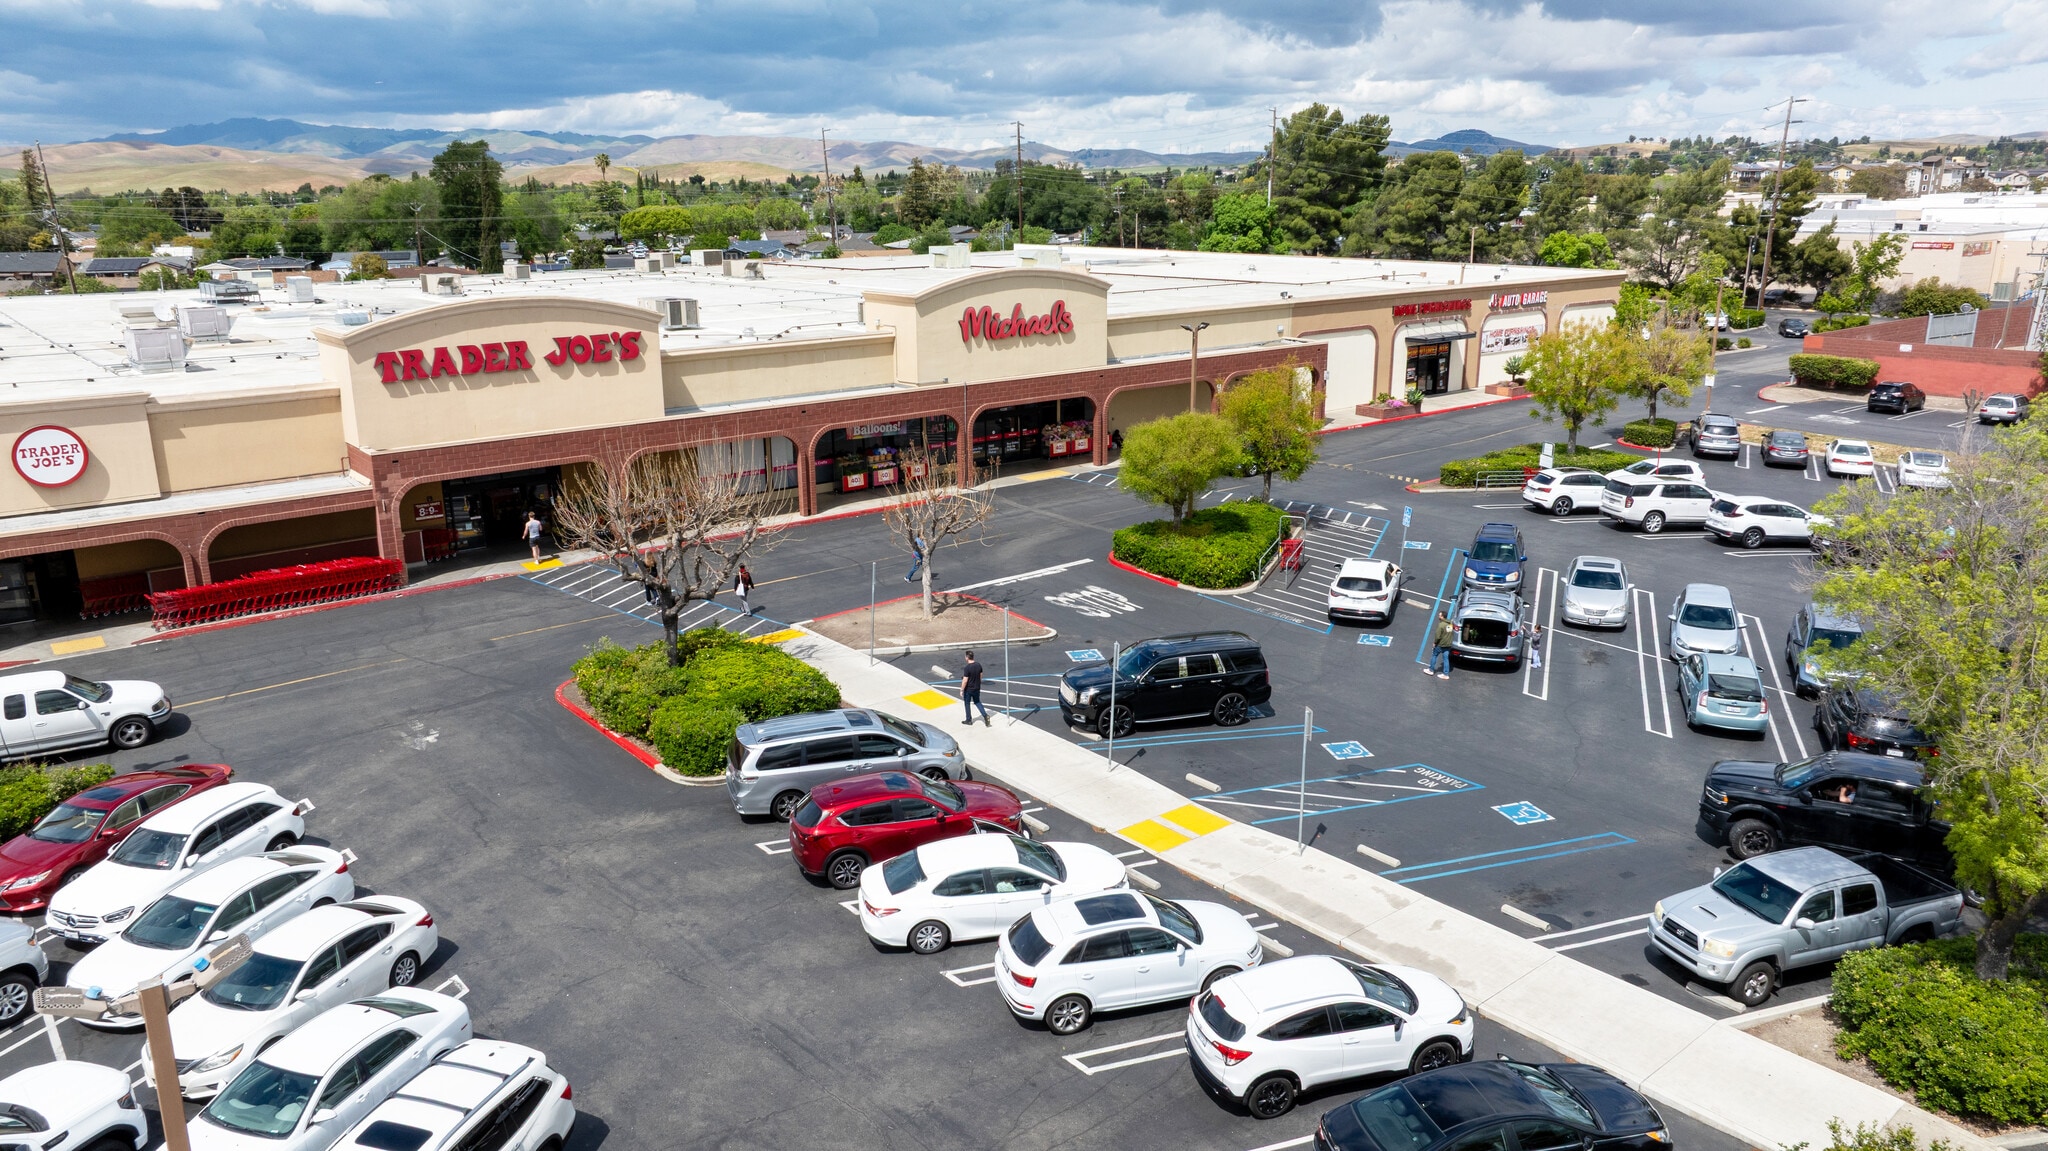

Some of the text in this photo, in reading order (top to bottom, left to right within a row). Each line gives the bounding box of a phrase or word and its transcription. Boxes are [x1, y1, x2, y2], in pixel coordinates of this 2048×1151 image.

[1501, 294, 1520, 307] AUTO
[1523, 291, 1548, 305] GARAGE
[958, 299, 1075, 343] Michaels
[373, 331, 642, 383] TRADER JOE'S
[853, 421, 901, 436] Balloons!
[19, 443, 80, 459] TRADER
[31, 455, 75, 469] JOE'S
[1044, 585, 1144, 618] STOP
[1413, 767, 1469, 789] PARKING
[1417, 778, 1440, 788] NO
